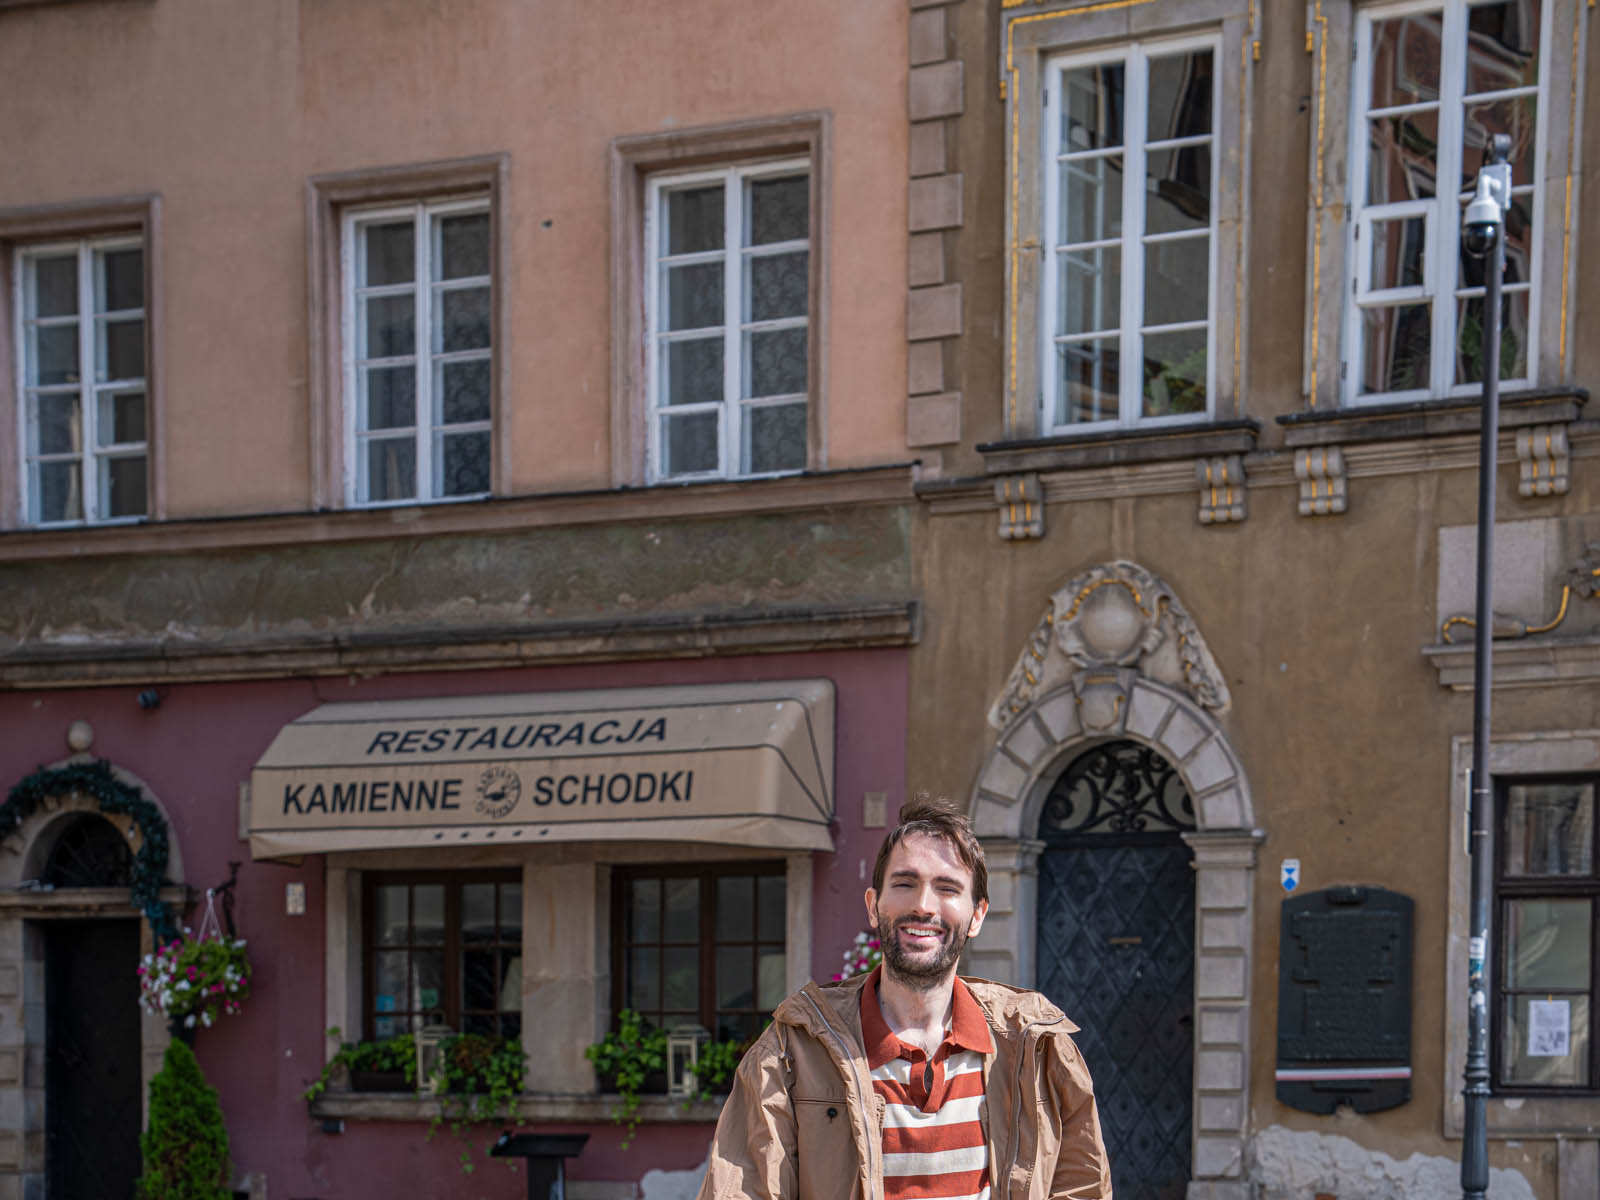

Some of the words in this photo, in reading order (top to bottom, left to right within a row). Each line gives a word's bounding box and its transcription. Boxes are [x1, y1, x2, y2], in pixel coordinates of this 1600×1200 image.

[366, 717, 667, 755] RESTAURACJA
[283, 778, 462, 815] KAMIENNE
[532, 770, 694, 806] SCHODKI
